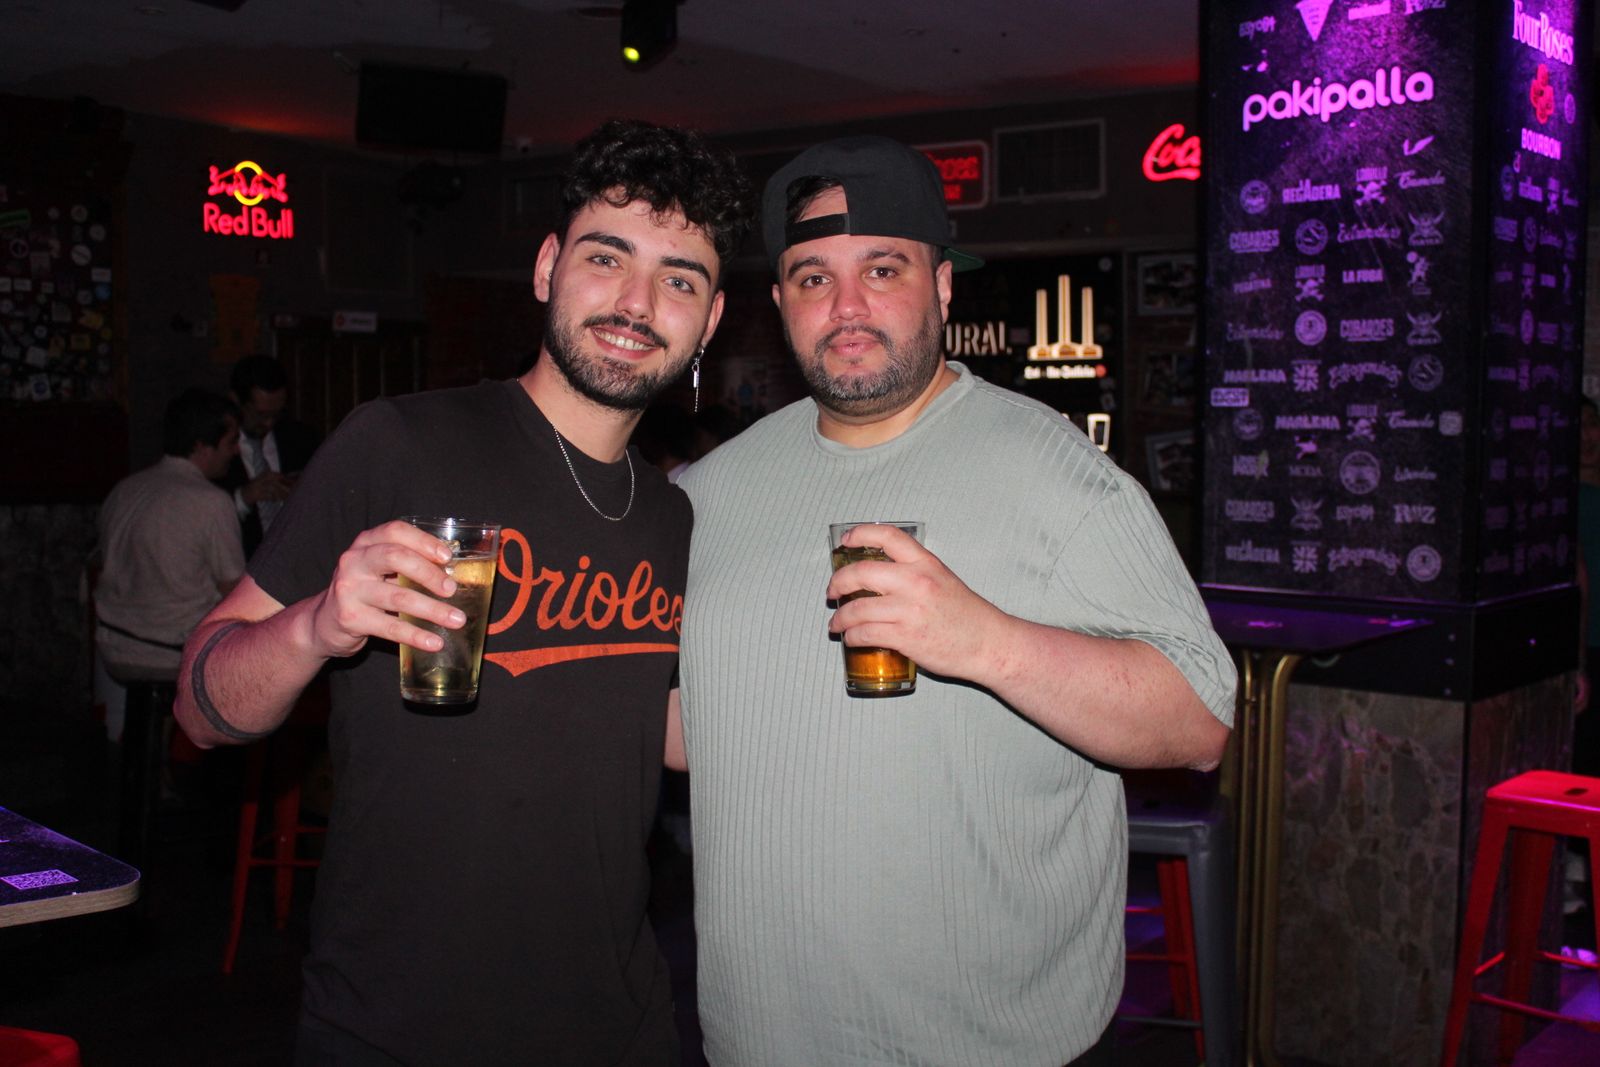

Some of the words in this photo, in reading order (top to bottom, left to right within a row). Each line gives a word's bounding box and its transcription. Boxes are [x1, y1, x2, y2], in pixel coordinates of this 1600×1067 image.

[1242, 66, 1434, 132] pakipalla
[1142, 123, 1201, 182] Coca
[203, 202, 250, 236] Red
[251, 206, 294, 239] Bull
